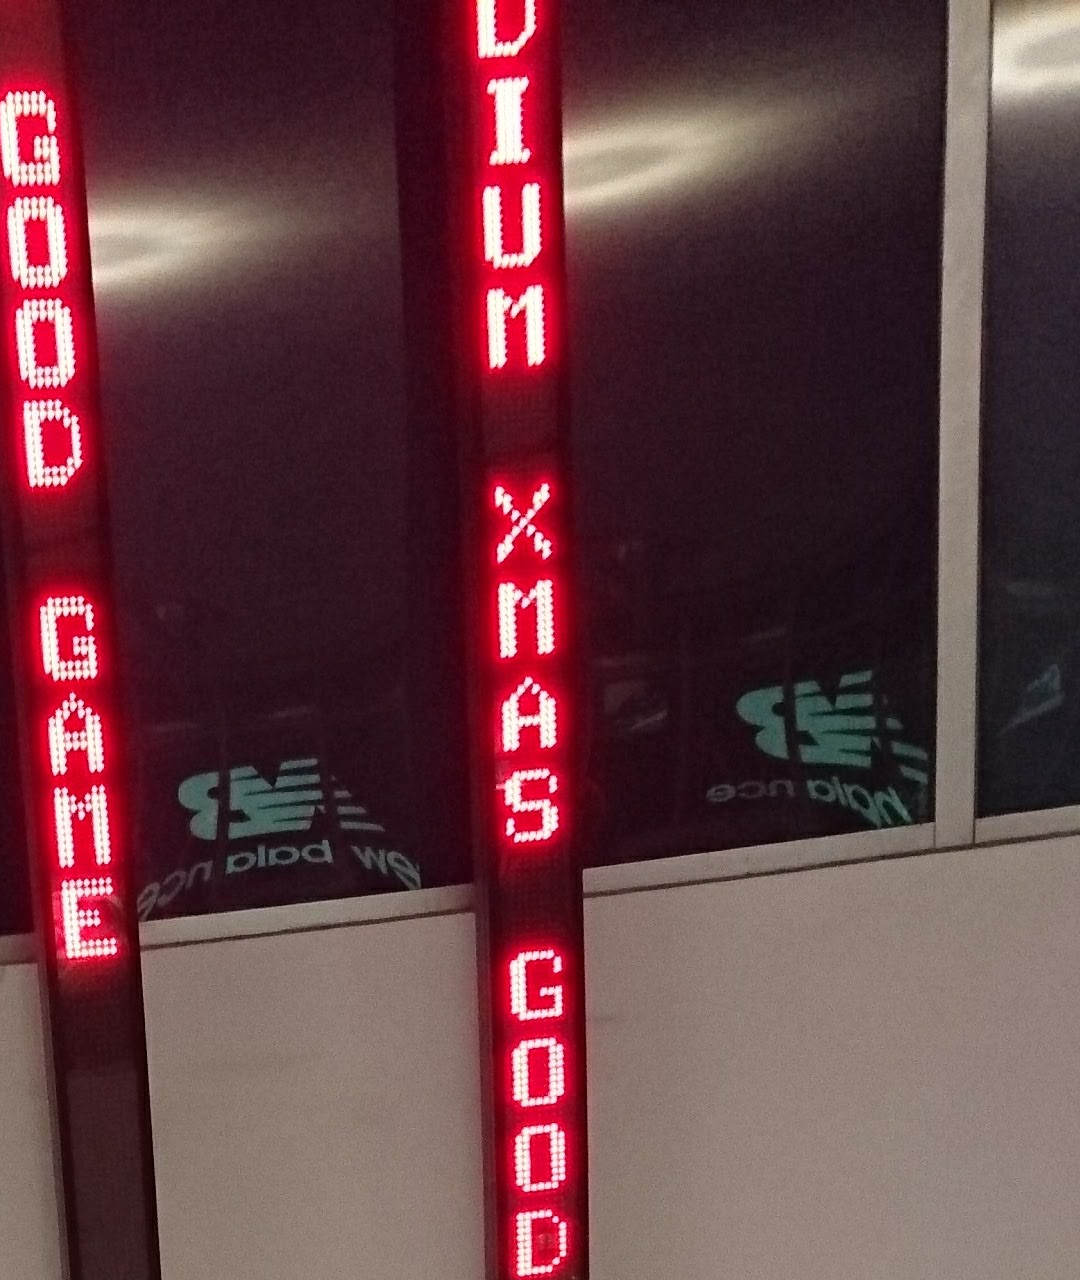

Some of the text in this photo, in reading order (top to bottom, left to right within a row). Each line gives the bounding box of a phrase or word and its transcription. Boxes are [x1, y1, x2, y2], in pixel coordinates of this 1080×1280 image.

[0, 91, 118, 958] GOOD GAME
[495, 484, 558, 843] XMAS
[510, 950, 567, 1276] GOOD
